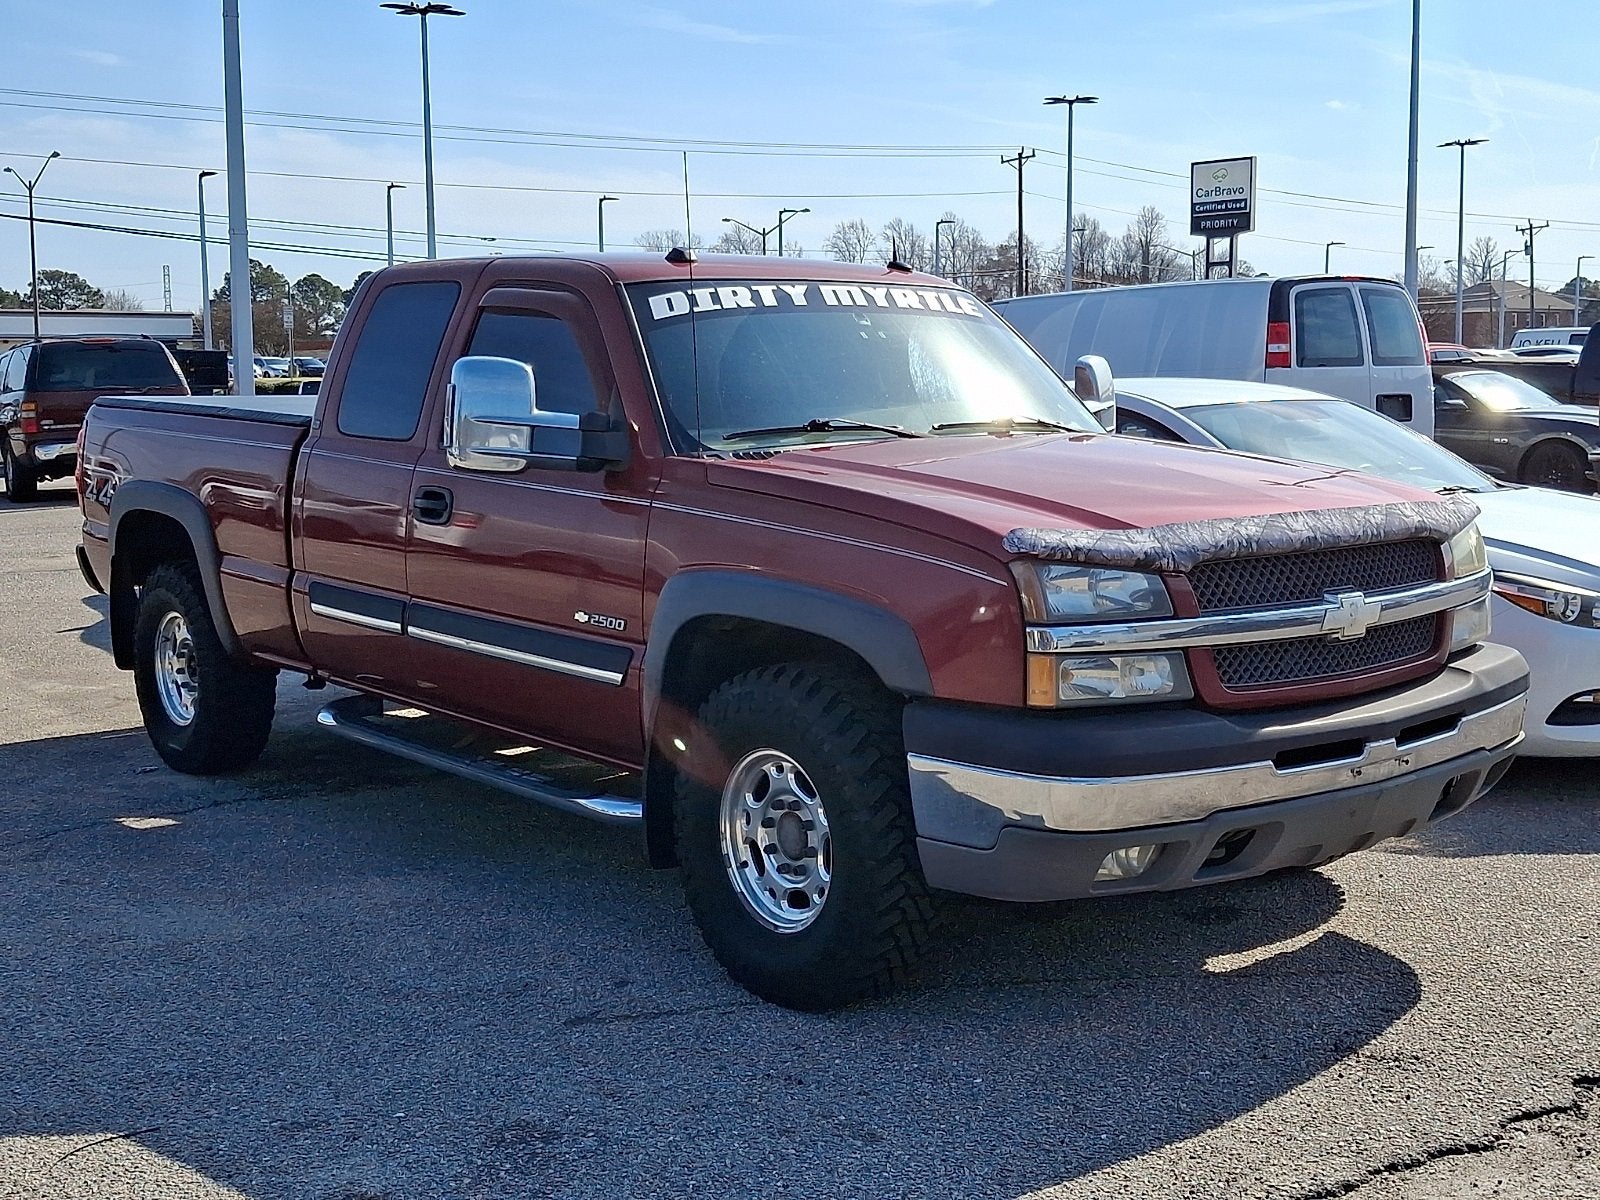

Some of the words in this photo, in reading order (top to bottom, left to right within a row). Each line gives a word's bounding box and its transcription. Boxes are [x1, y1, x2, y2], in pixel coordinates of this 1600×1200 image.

[1195, 186, 1245, 198] CarBravo
[1195, 203, 1226, 212] Certified
[1227, 201, 1245, 209] Used
[1200, 219, 1238, 229] PRIORITY
[648, 284, 808, 321] DIRTY
[818, 284, 984, 318] MYRTLE
[590, 614, 625, 631] 2500
